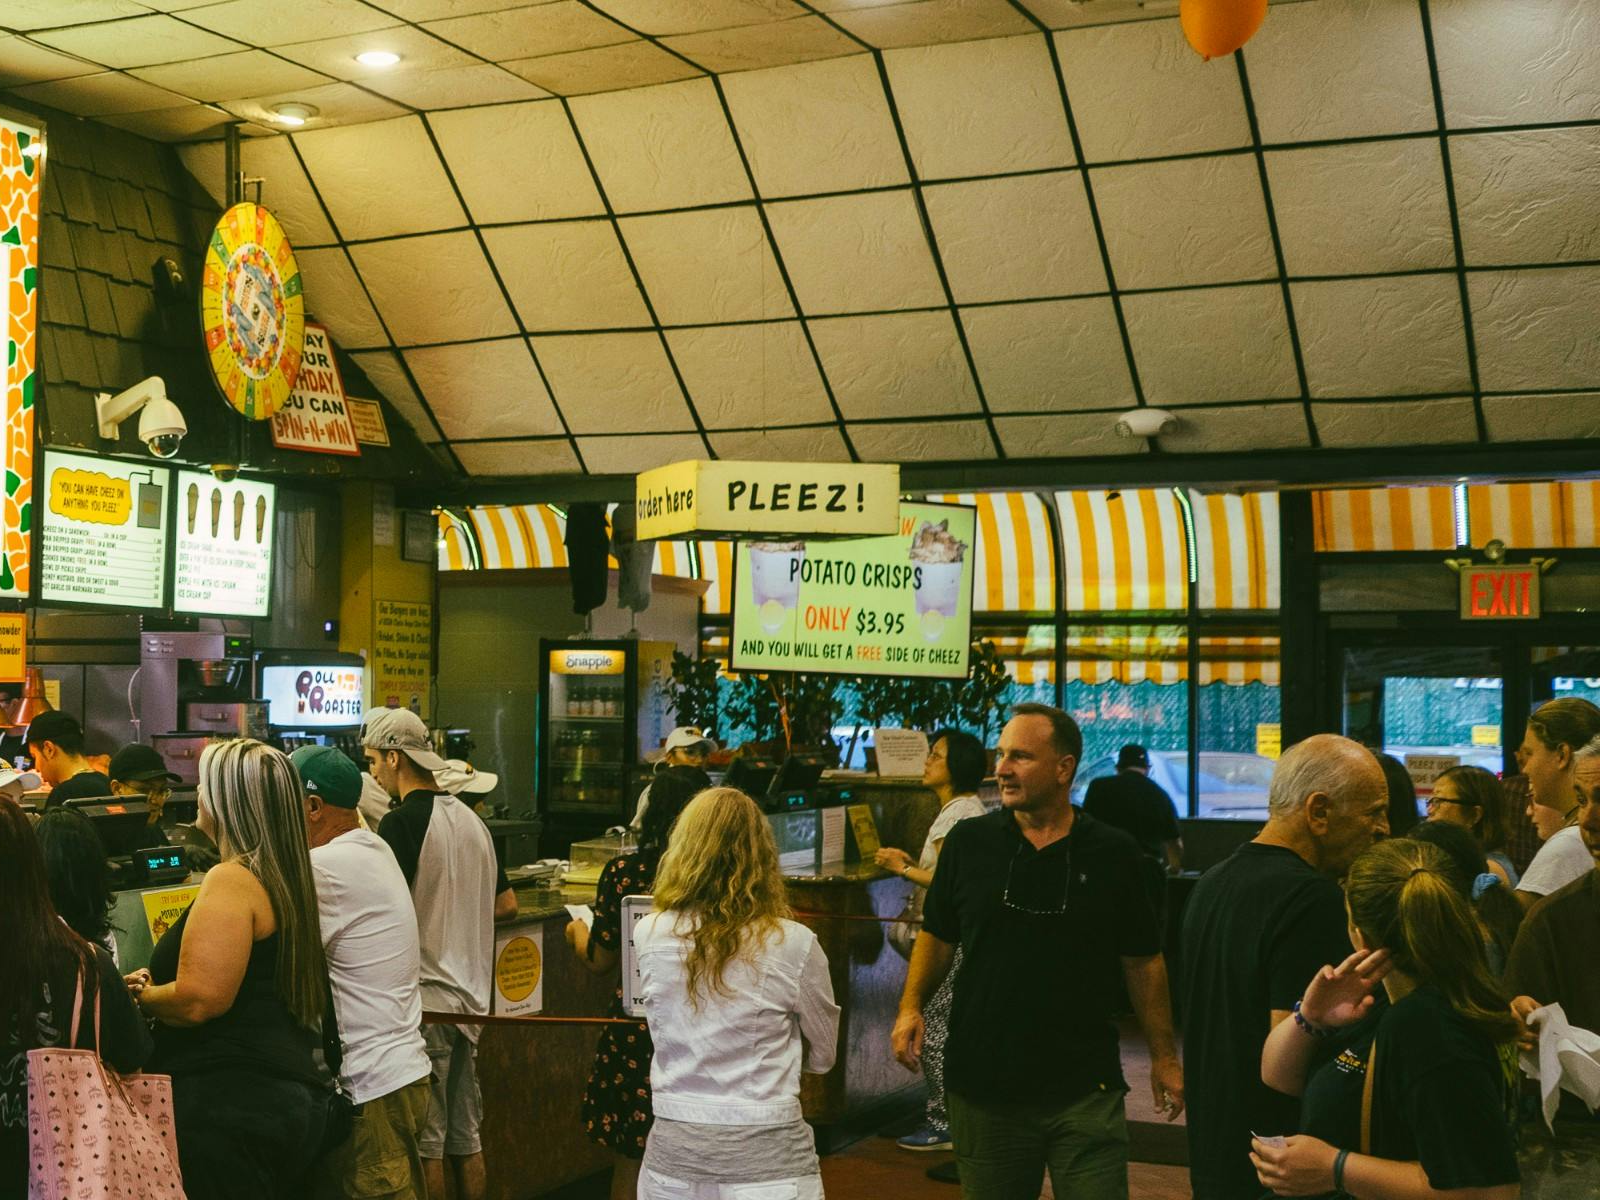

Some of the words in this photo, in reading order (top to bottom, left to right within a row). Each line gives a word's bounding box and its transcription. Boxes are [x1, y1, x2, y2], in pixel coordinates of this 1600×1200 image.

[309, 398, 345, 415] CAN
[638, 490, 662, 520] order
[665, 487, 693, 514] here
[728, 480, 863, 512] PLEEZ!
[790, 558, 855, 585] POTATO
[862, 562, 922, 590] CRISPS
[1471, 571, 1532, 616] EXIT
[805, 606, 849, 630] ONLY
[855, 608, 904, 636] $3.95
[565, 654, 613, 670] Snapple
[741, 639, 764, 655] AND
[768, 641, 790, 656] YOU
[794, 642, 819, 657] WILL
[822, 644, 842, 659] GET
[845, 645, 852, 659] A
[857, 646, 880, 660] FREE
[886, 647, 908, 662] SIDE
[912, 648, 925, 663] OF
[928, 648, 960, 664] CHEEZ
